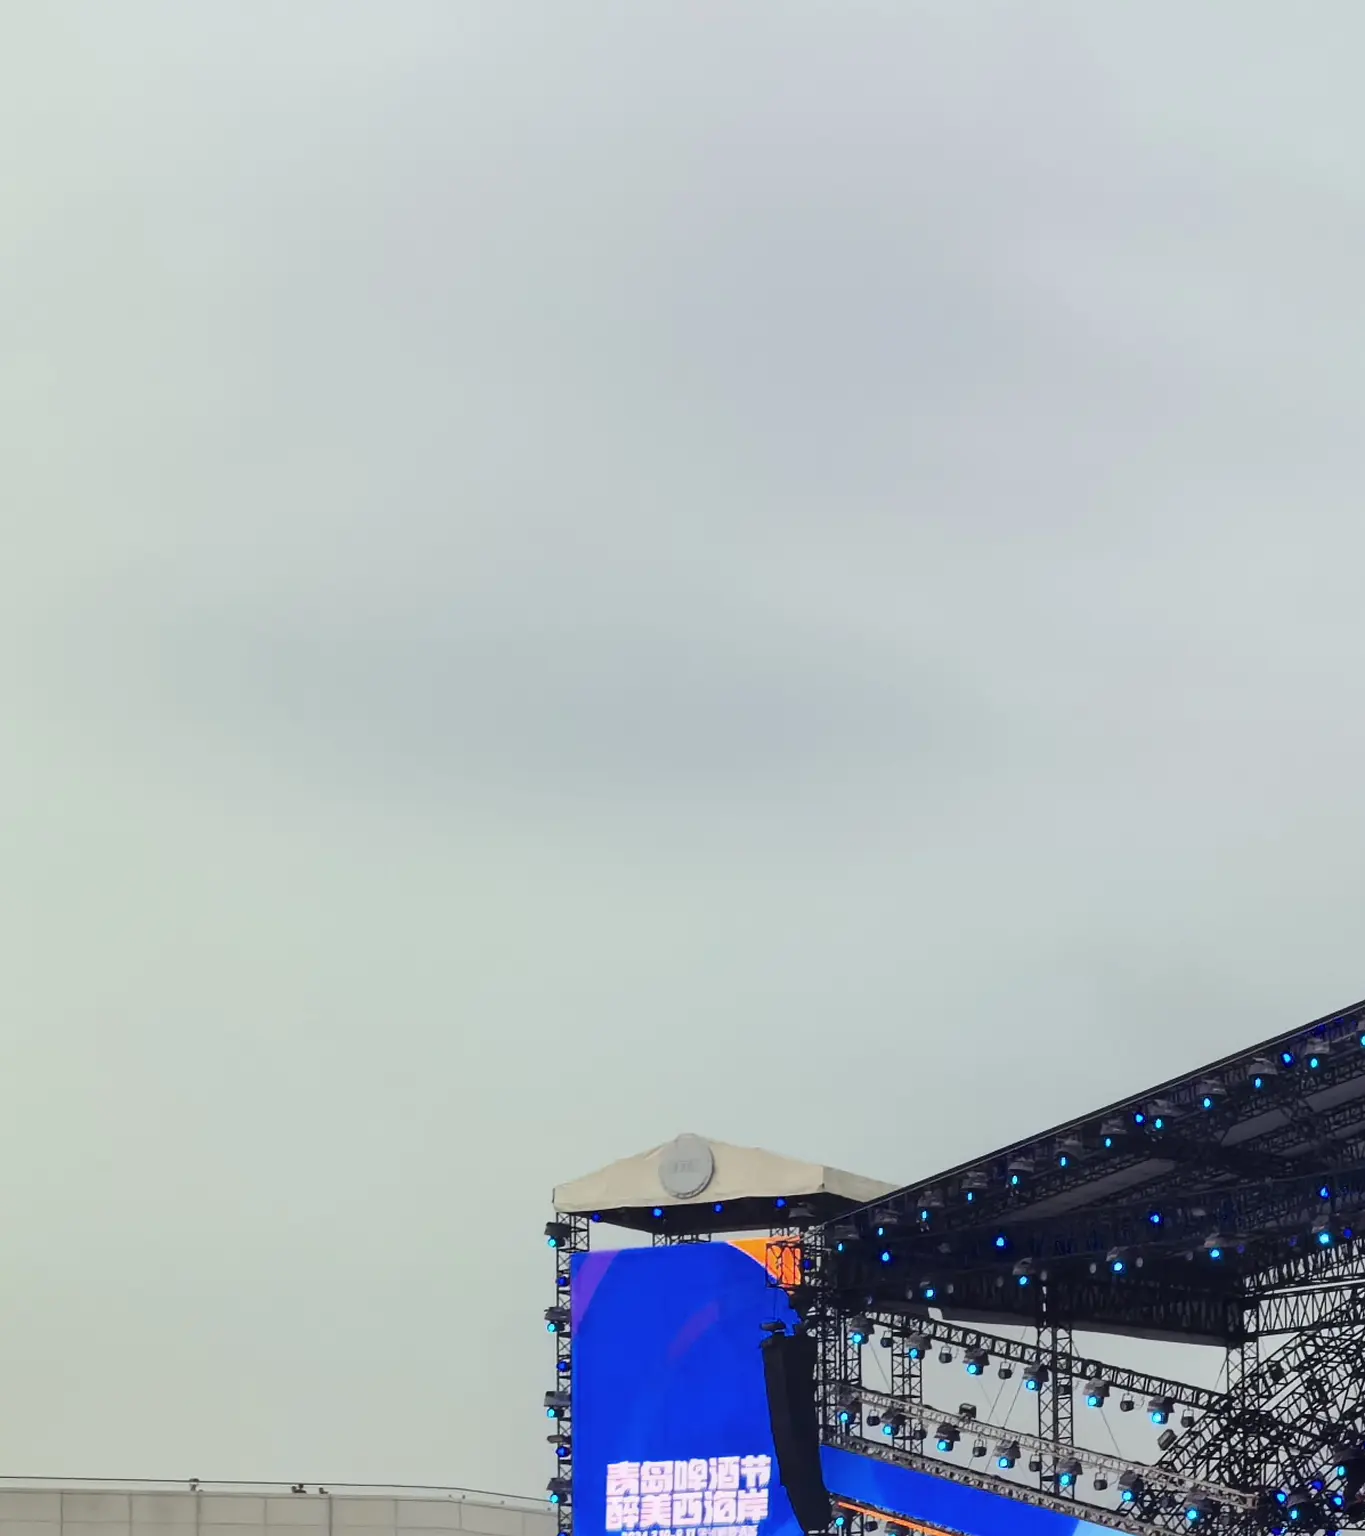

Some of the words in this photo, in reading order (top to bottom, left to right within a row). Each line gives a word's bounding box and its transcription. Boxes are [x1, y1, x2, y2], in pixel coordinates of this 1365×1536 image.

[606, 1454, 771, 1496] 青岛啤酒节
[605, 1488, 769, 1531] 醉美西海岸
